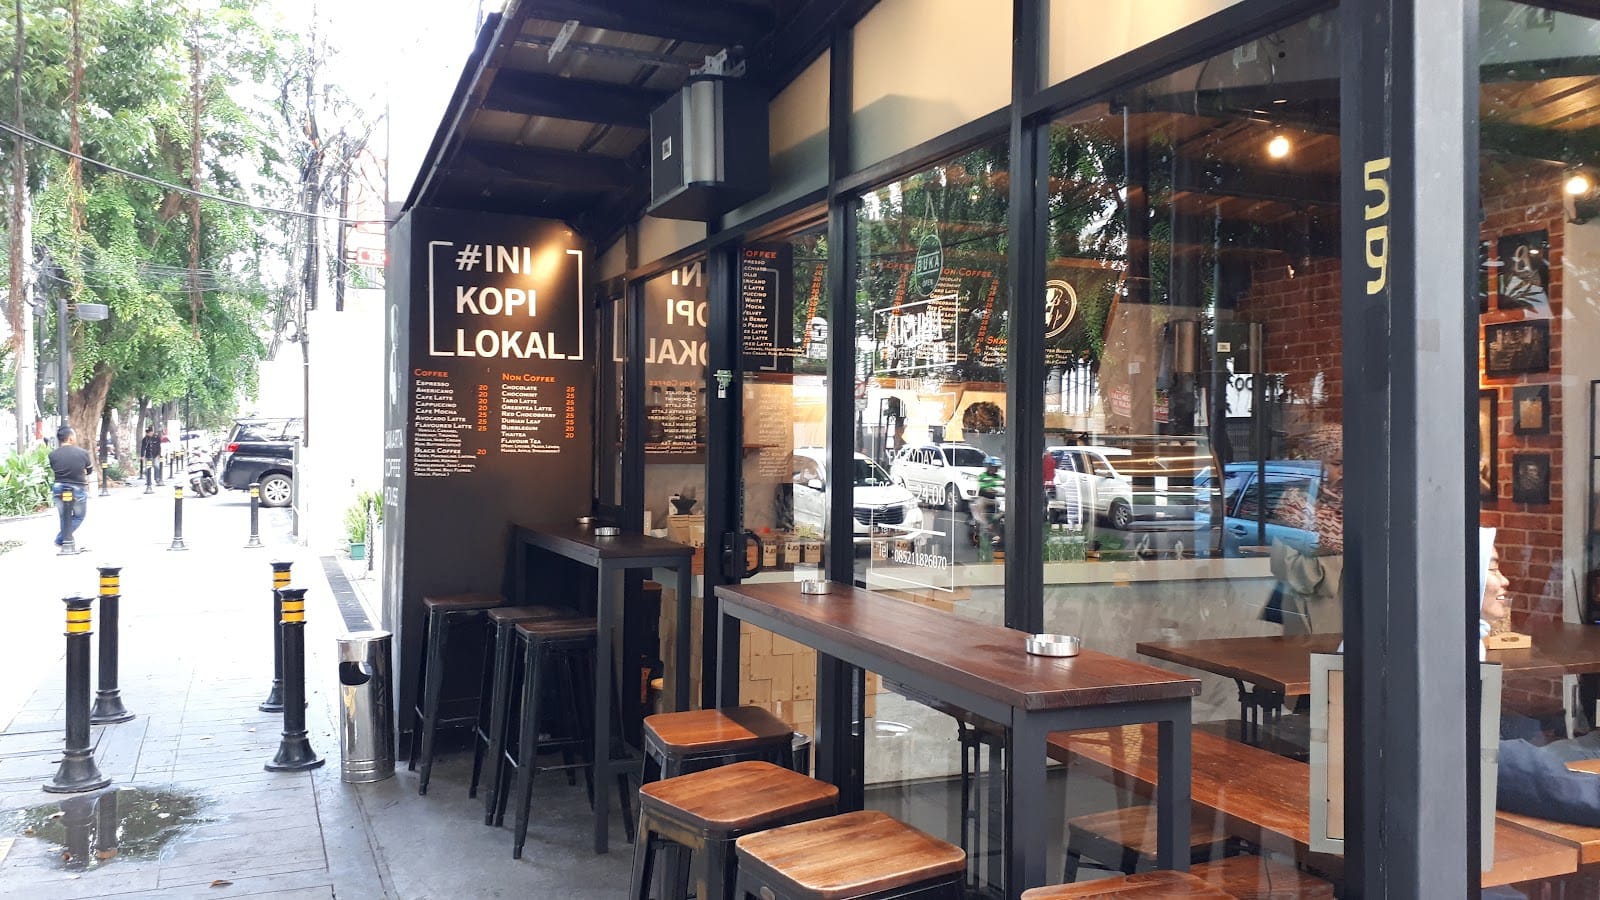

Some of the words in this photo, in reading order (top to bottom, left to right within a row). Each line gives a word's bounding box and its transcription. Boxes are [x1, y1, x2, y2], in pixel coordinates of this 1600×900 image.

[455, 244, 532, 275] #INI
[745, 250, 777, 259] OFFEE
[917, 256, 940, 272] BUKA
[959, 267, 993, 278] COFFEE
[456, 286, 537, 317] KOPI
[456, 328, 566, 360] LOKAL
[415, 369, 449, 378] COFFEE
[502, 373, 521, 381] NON
[523, 374, 556, 383] COFFEE
[917, 484, 946, 506] 24.00
[880, 541, 889, 559] Tel
